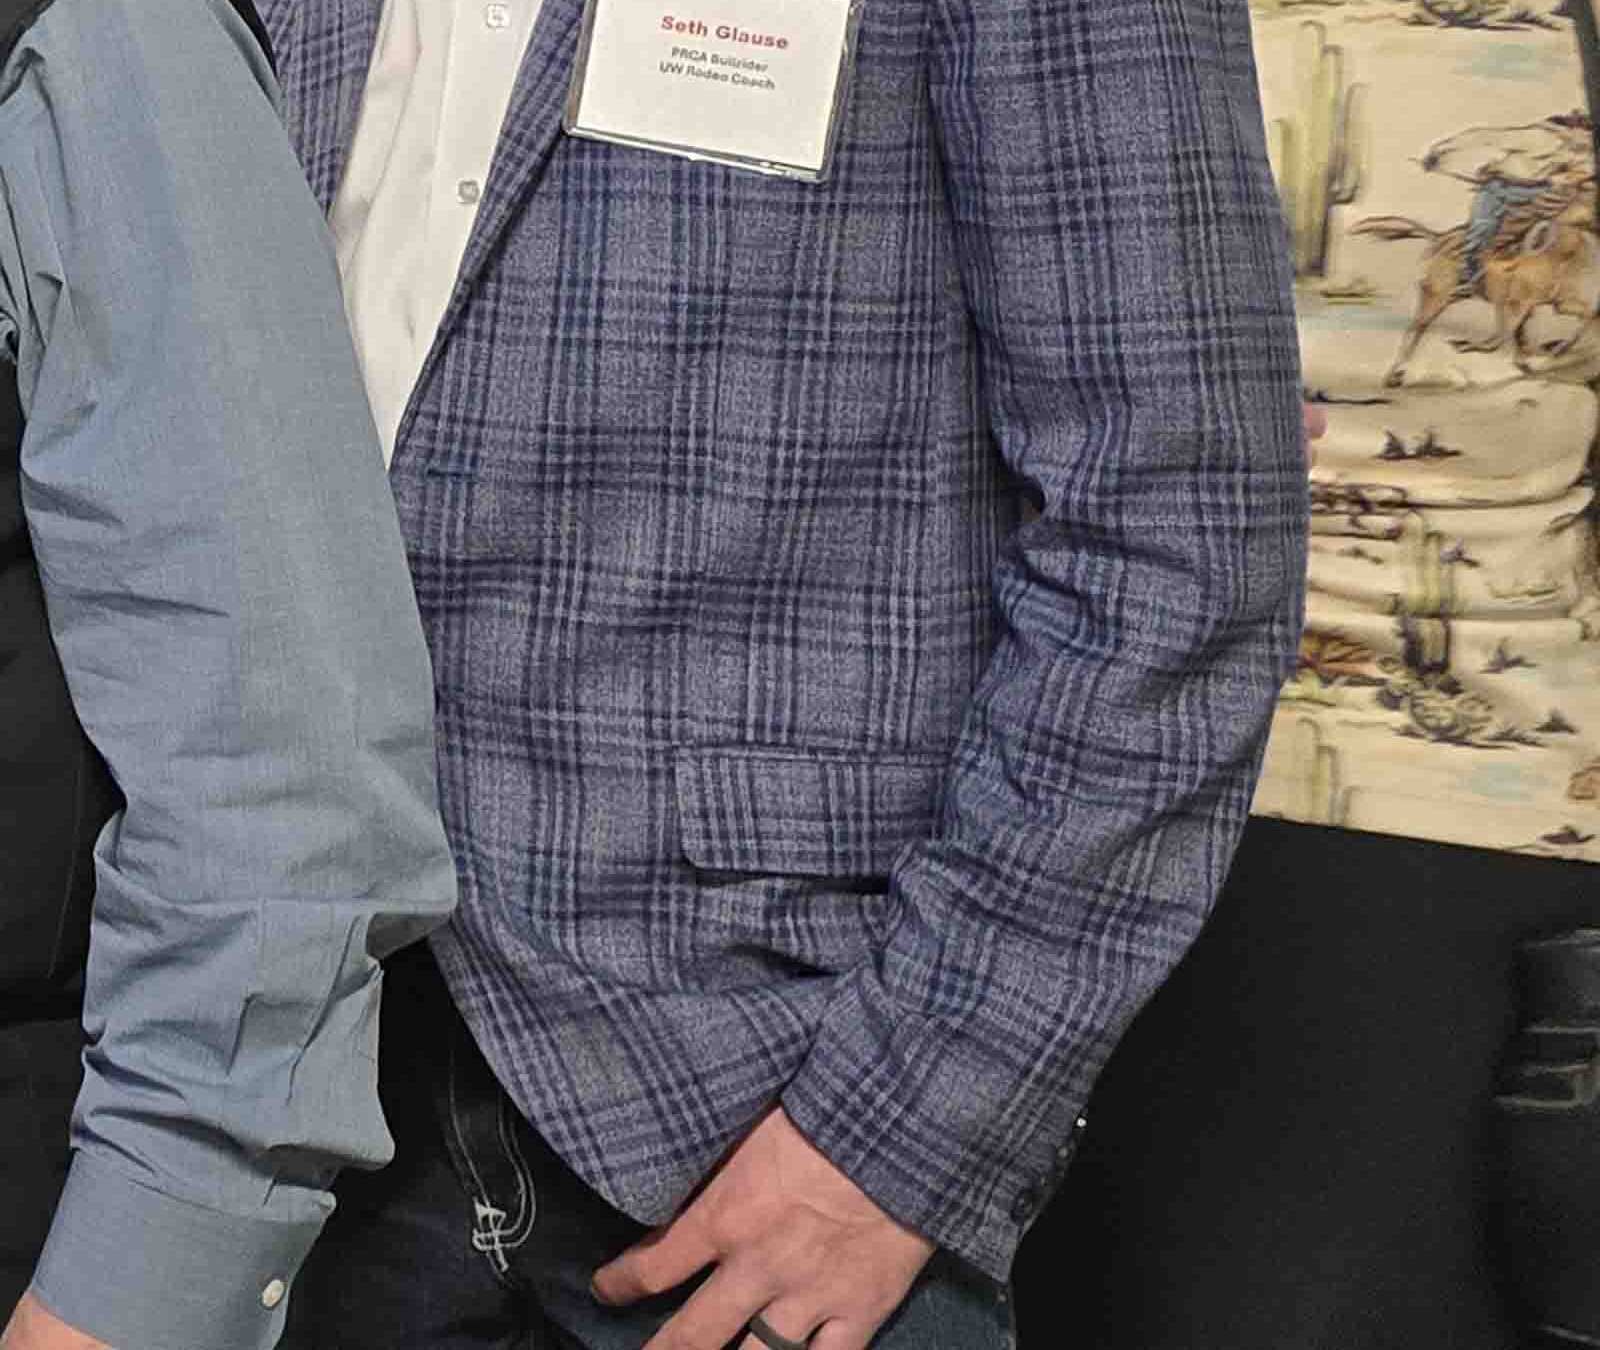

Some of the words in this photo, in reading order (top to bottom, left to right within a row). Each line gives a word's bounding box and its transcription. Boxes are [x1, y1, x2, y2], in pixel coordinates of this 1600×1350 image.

[660, 15, 709, 37] Seth
[715, 25, 789, 50] Glause
[671, 46, 708, 63] PRCA
[711, 53, 769, 73] Bullrider
[659, 61, 685, 76] UW
[687, 65, 729, 83] Rodeo
[731, 72, 776, 90] Coach
